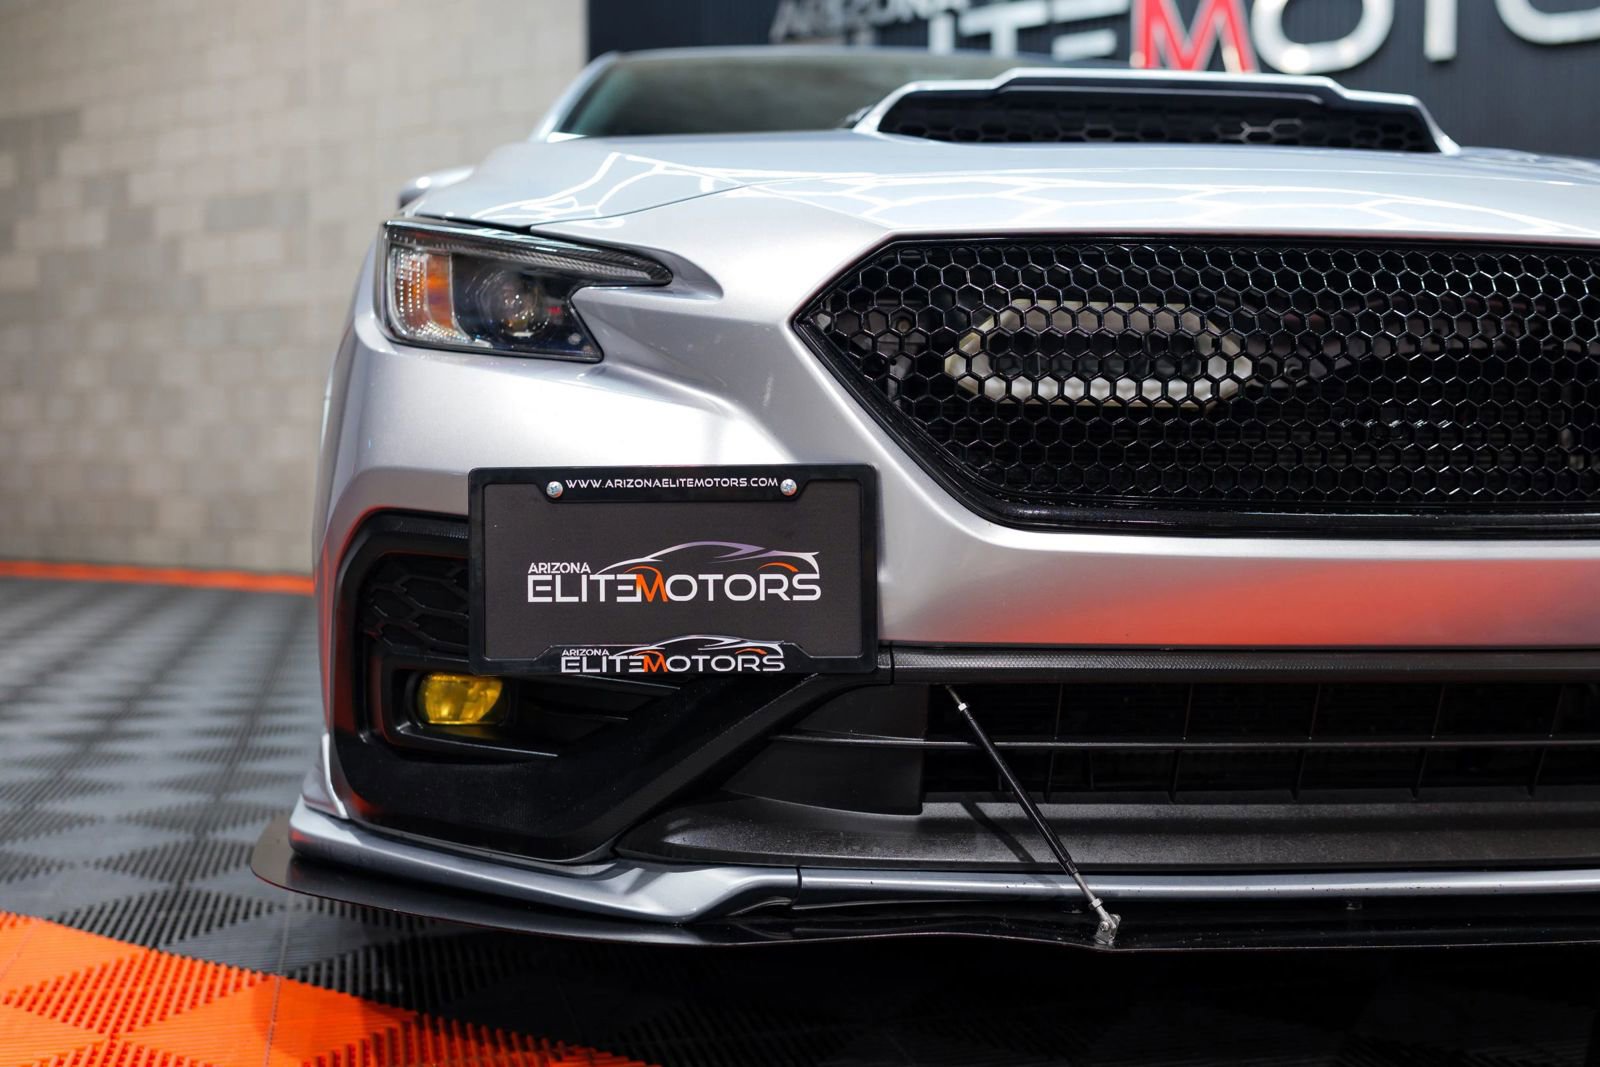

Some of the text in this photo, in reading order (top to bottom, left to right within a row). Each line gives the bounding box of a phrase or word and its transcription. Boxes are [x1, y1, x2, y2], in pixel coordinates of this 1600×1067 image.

[565, 477, 778, 489] WWW.ARIZONAELITEMOTORS.COM
[528, 562, 591, 574] ARIZONA
[561, 649, 610, 657] ARIZONA
